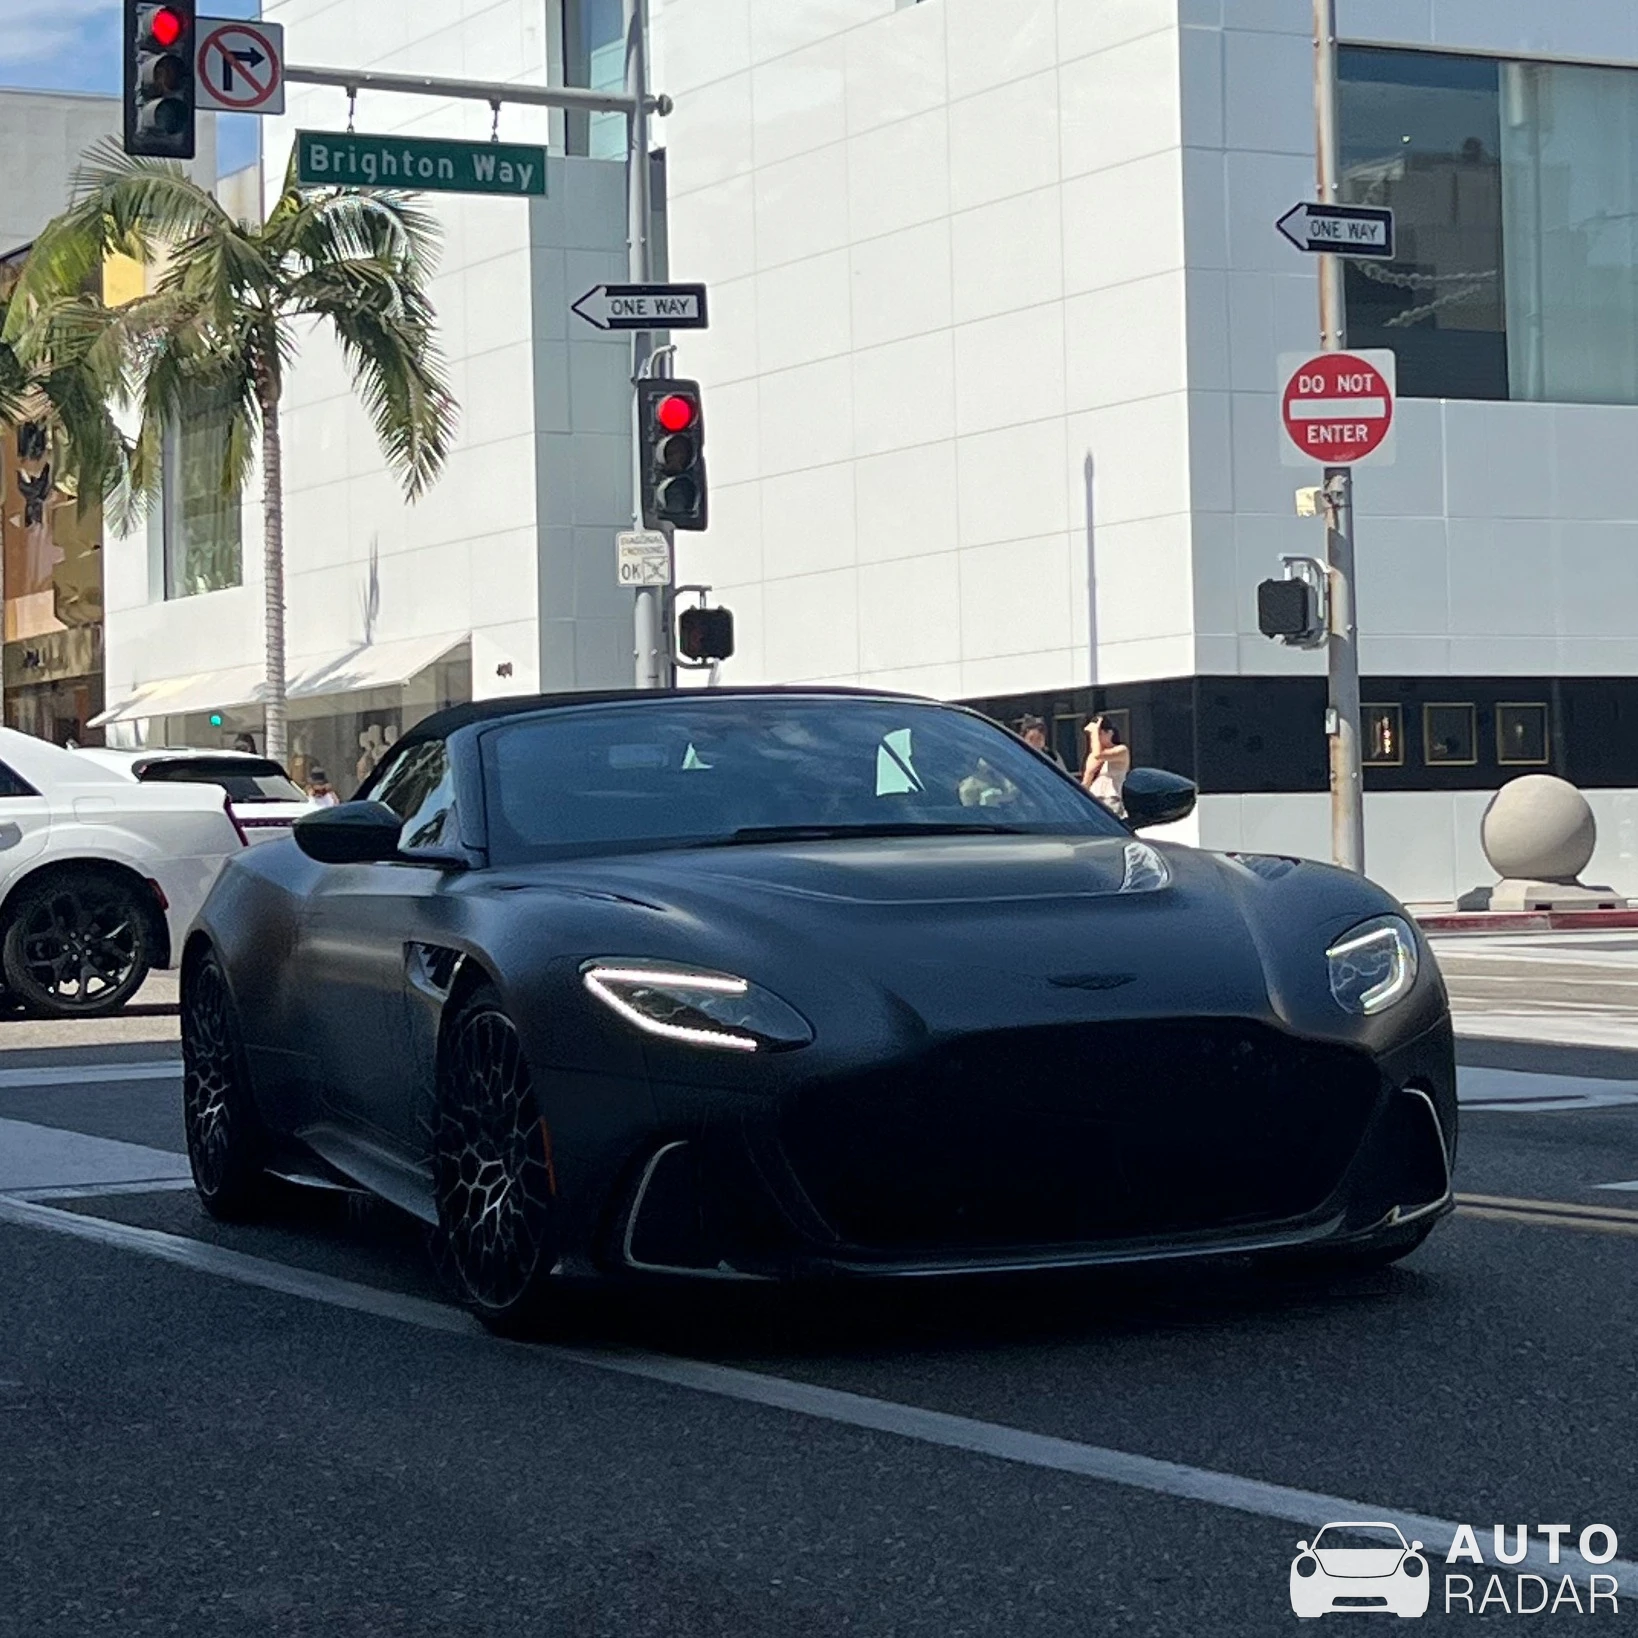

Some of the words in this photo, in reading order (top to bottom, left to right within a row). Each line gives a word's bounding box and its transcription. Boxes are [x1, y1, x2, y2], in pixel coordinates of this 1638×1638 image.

[309, 143, 454, 184] Brighton
[472, 153, 535, 191] Way
[1310, 219, 1342, 239] ONE
[1347, 222, 1378, 241] WAY
[611, 298, 648, 316] ONE
[654, 298, 690, 315] WAY
[1298, 374, 1325, 394] DO
[1337, 373, 1375, 392] NOT
[1307, 424, 1368, 444] ENTER
[621, 563, 642, 581] OK
